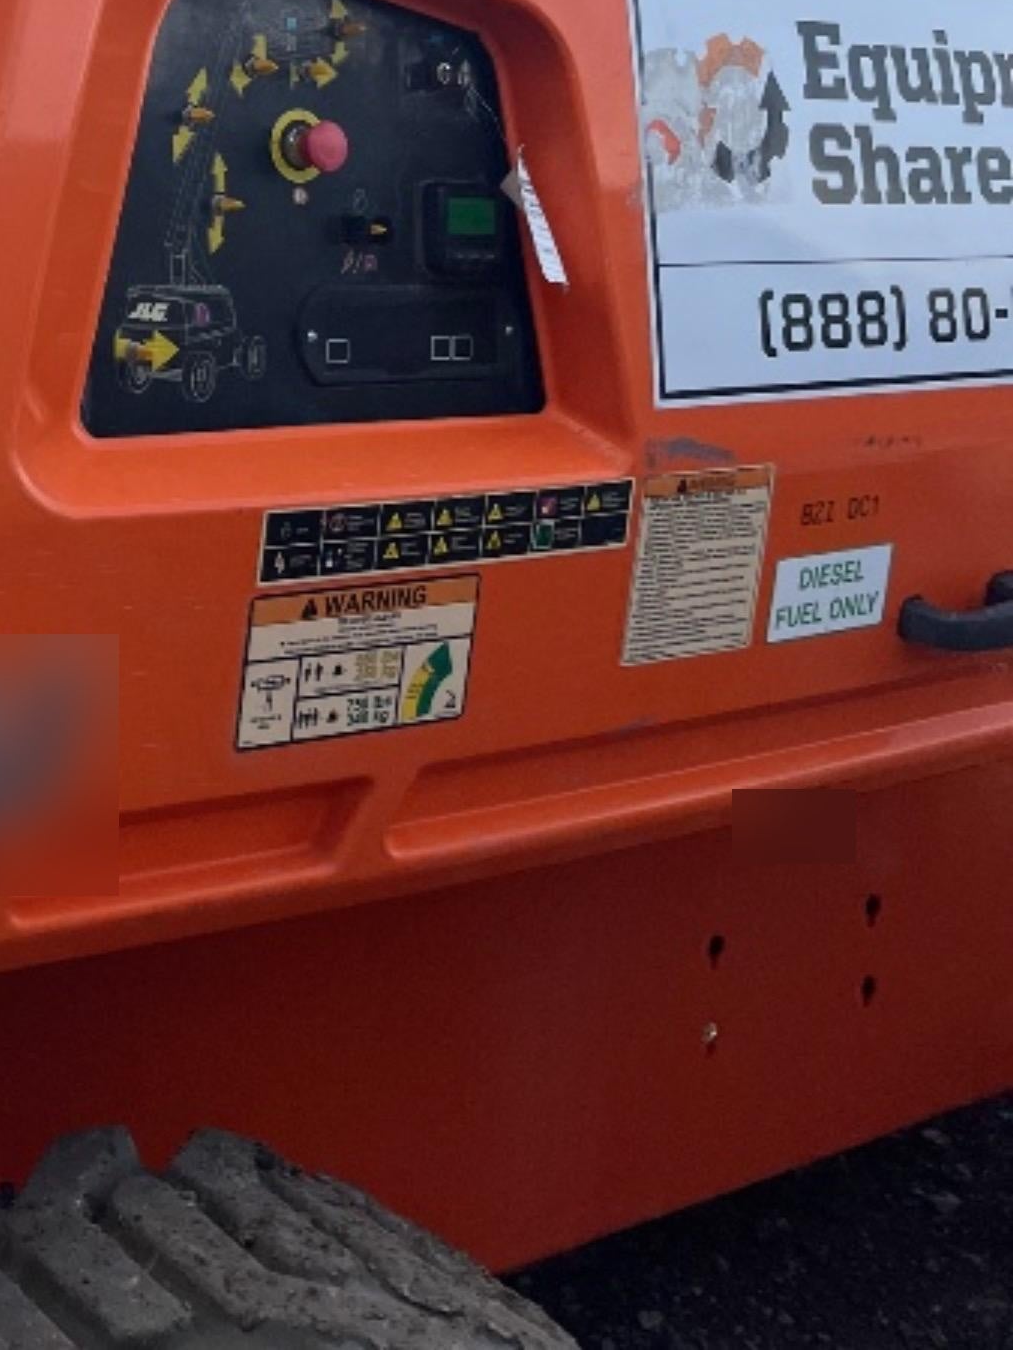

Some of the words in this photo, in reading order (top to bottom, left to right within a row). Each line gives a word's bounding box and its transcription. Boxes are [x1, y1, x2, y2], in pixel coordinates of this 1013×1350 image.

[809, 122, 1013, 205] Share
[759, 284, 907, 358] (888)
[927, 287, 1013, 343] 80-
[799, 560, 865, 590] DIESEL
[325, 586, 427, 618] WARNING
[775, 600, 822, 629] FUEL
[829, 590, 880, 620] ONLY
